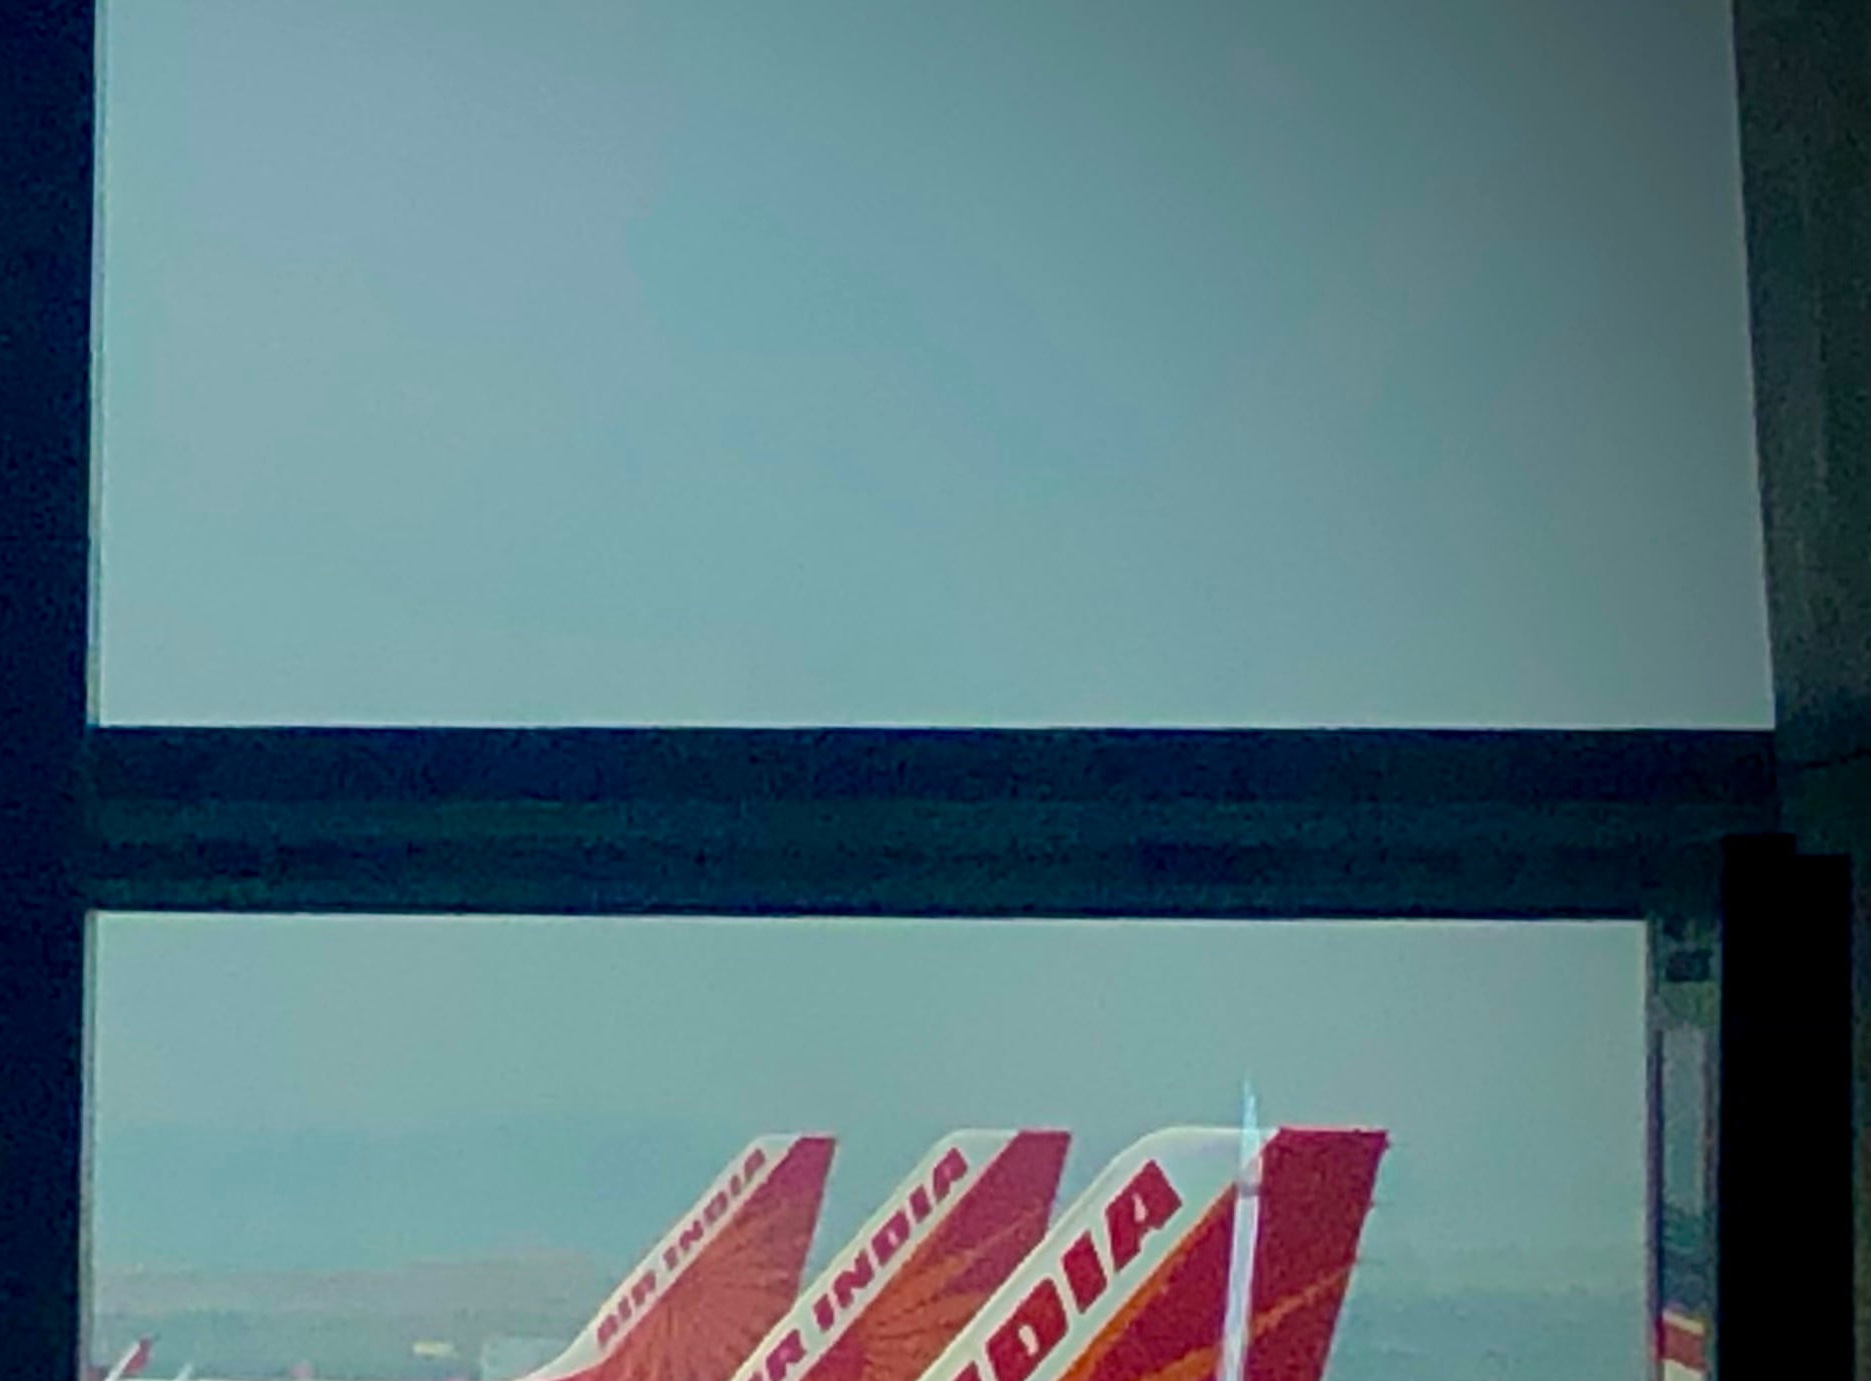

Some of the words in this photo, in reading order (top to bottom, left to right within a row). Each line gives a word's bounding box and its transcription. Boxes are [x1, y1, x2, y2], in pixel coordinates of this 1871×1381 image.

[596, 1267, 656, 1347] AIR
[662, 1148, 766, 1271] INDIA
[813, 1147, 968, 1333] INDIA
